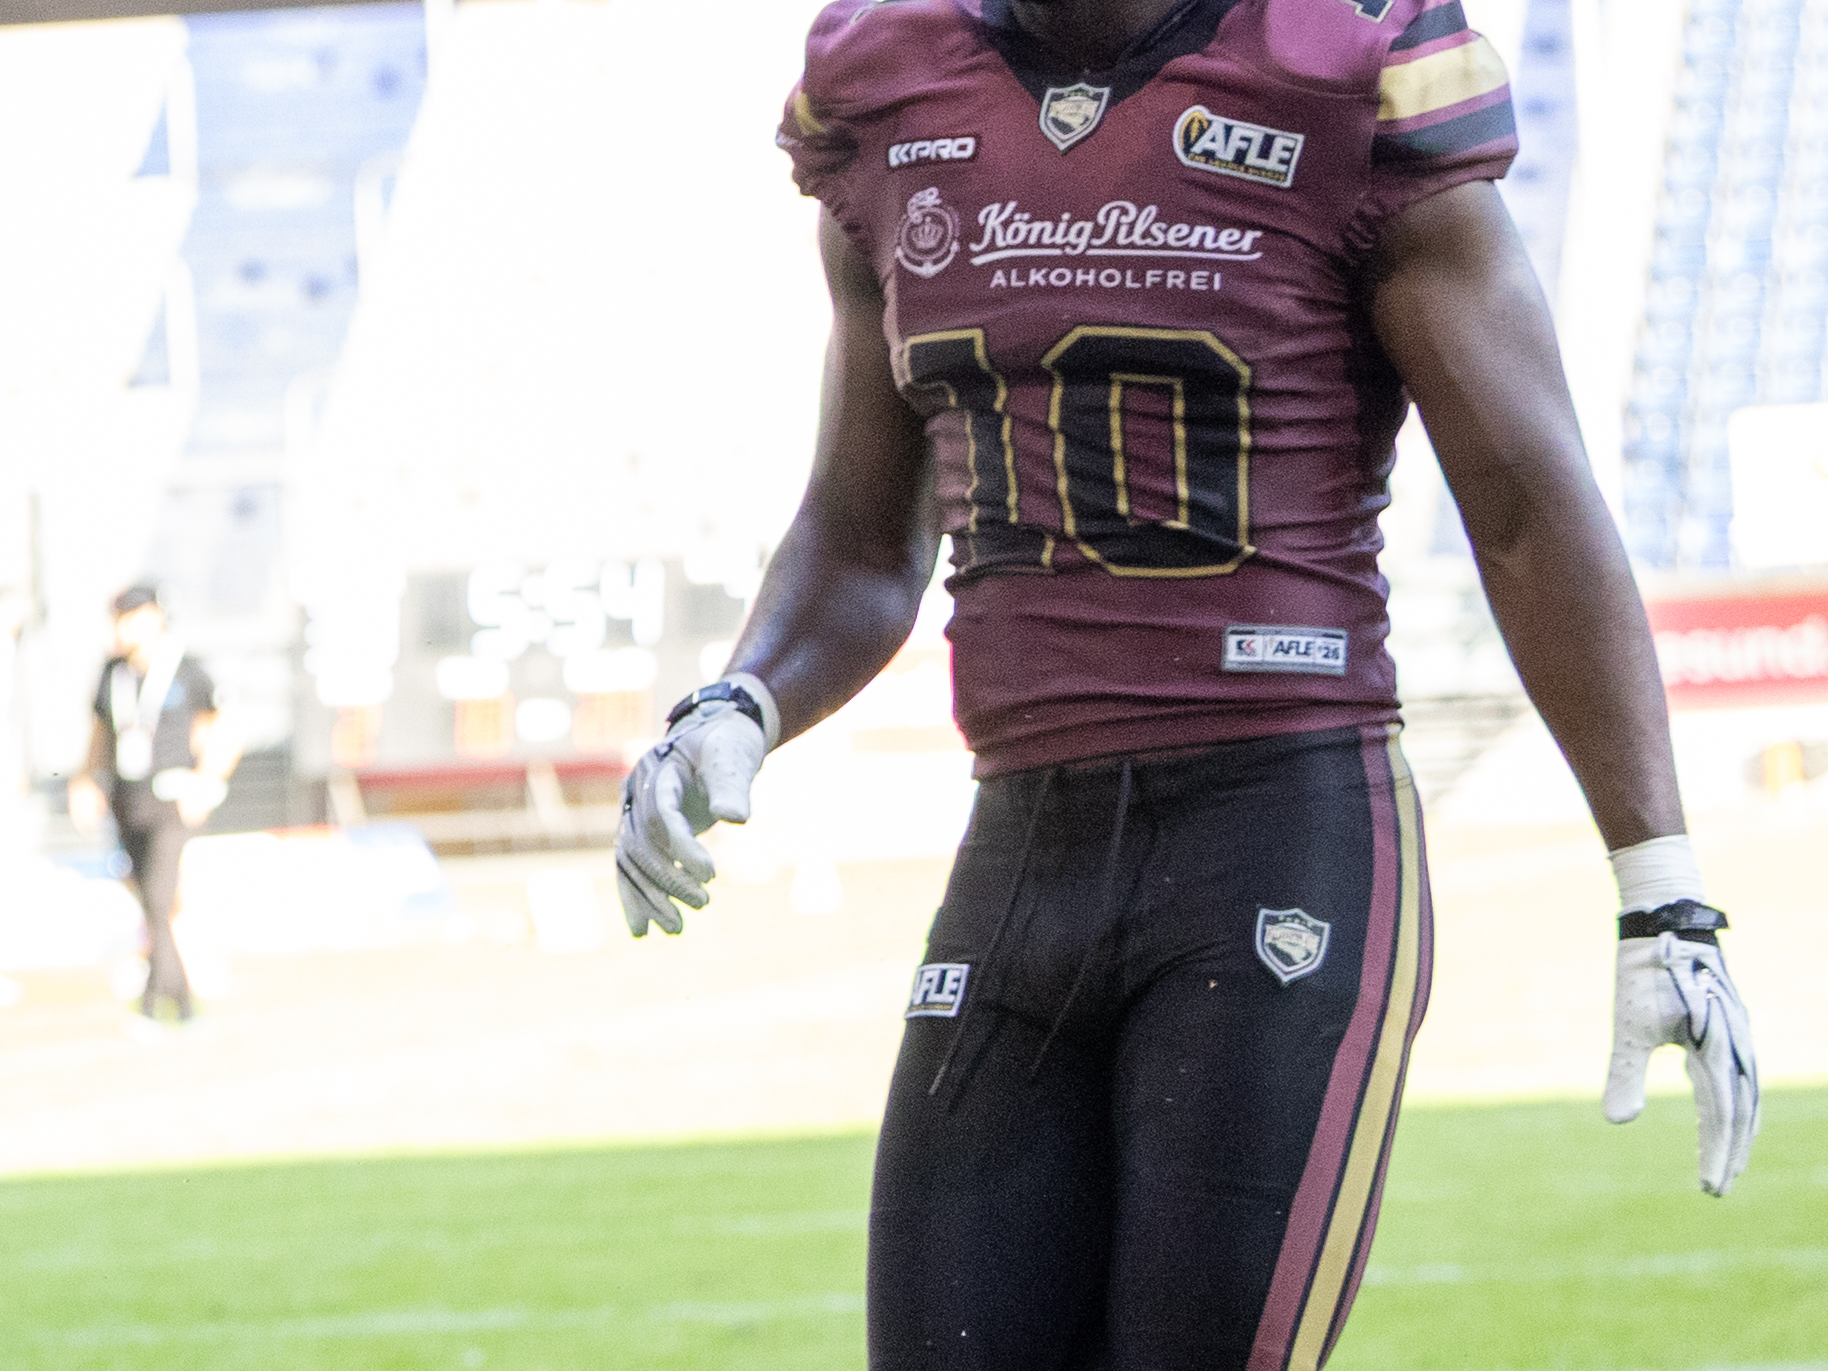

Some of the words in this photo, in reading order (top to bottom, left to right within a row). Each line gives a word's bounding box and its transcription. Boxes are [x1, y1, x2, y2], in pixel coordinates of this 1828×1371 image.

[1190, 118, 1298, 174] AFLE
[989, 267, 1224, 292] ALKOHOLFREI
[900, 324, 1258, 578] 10
